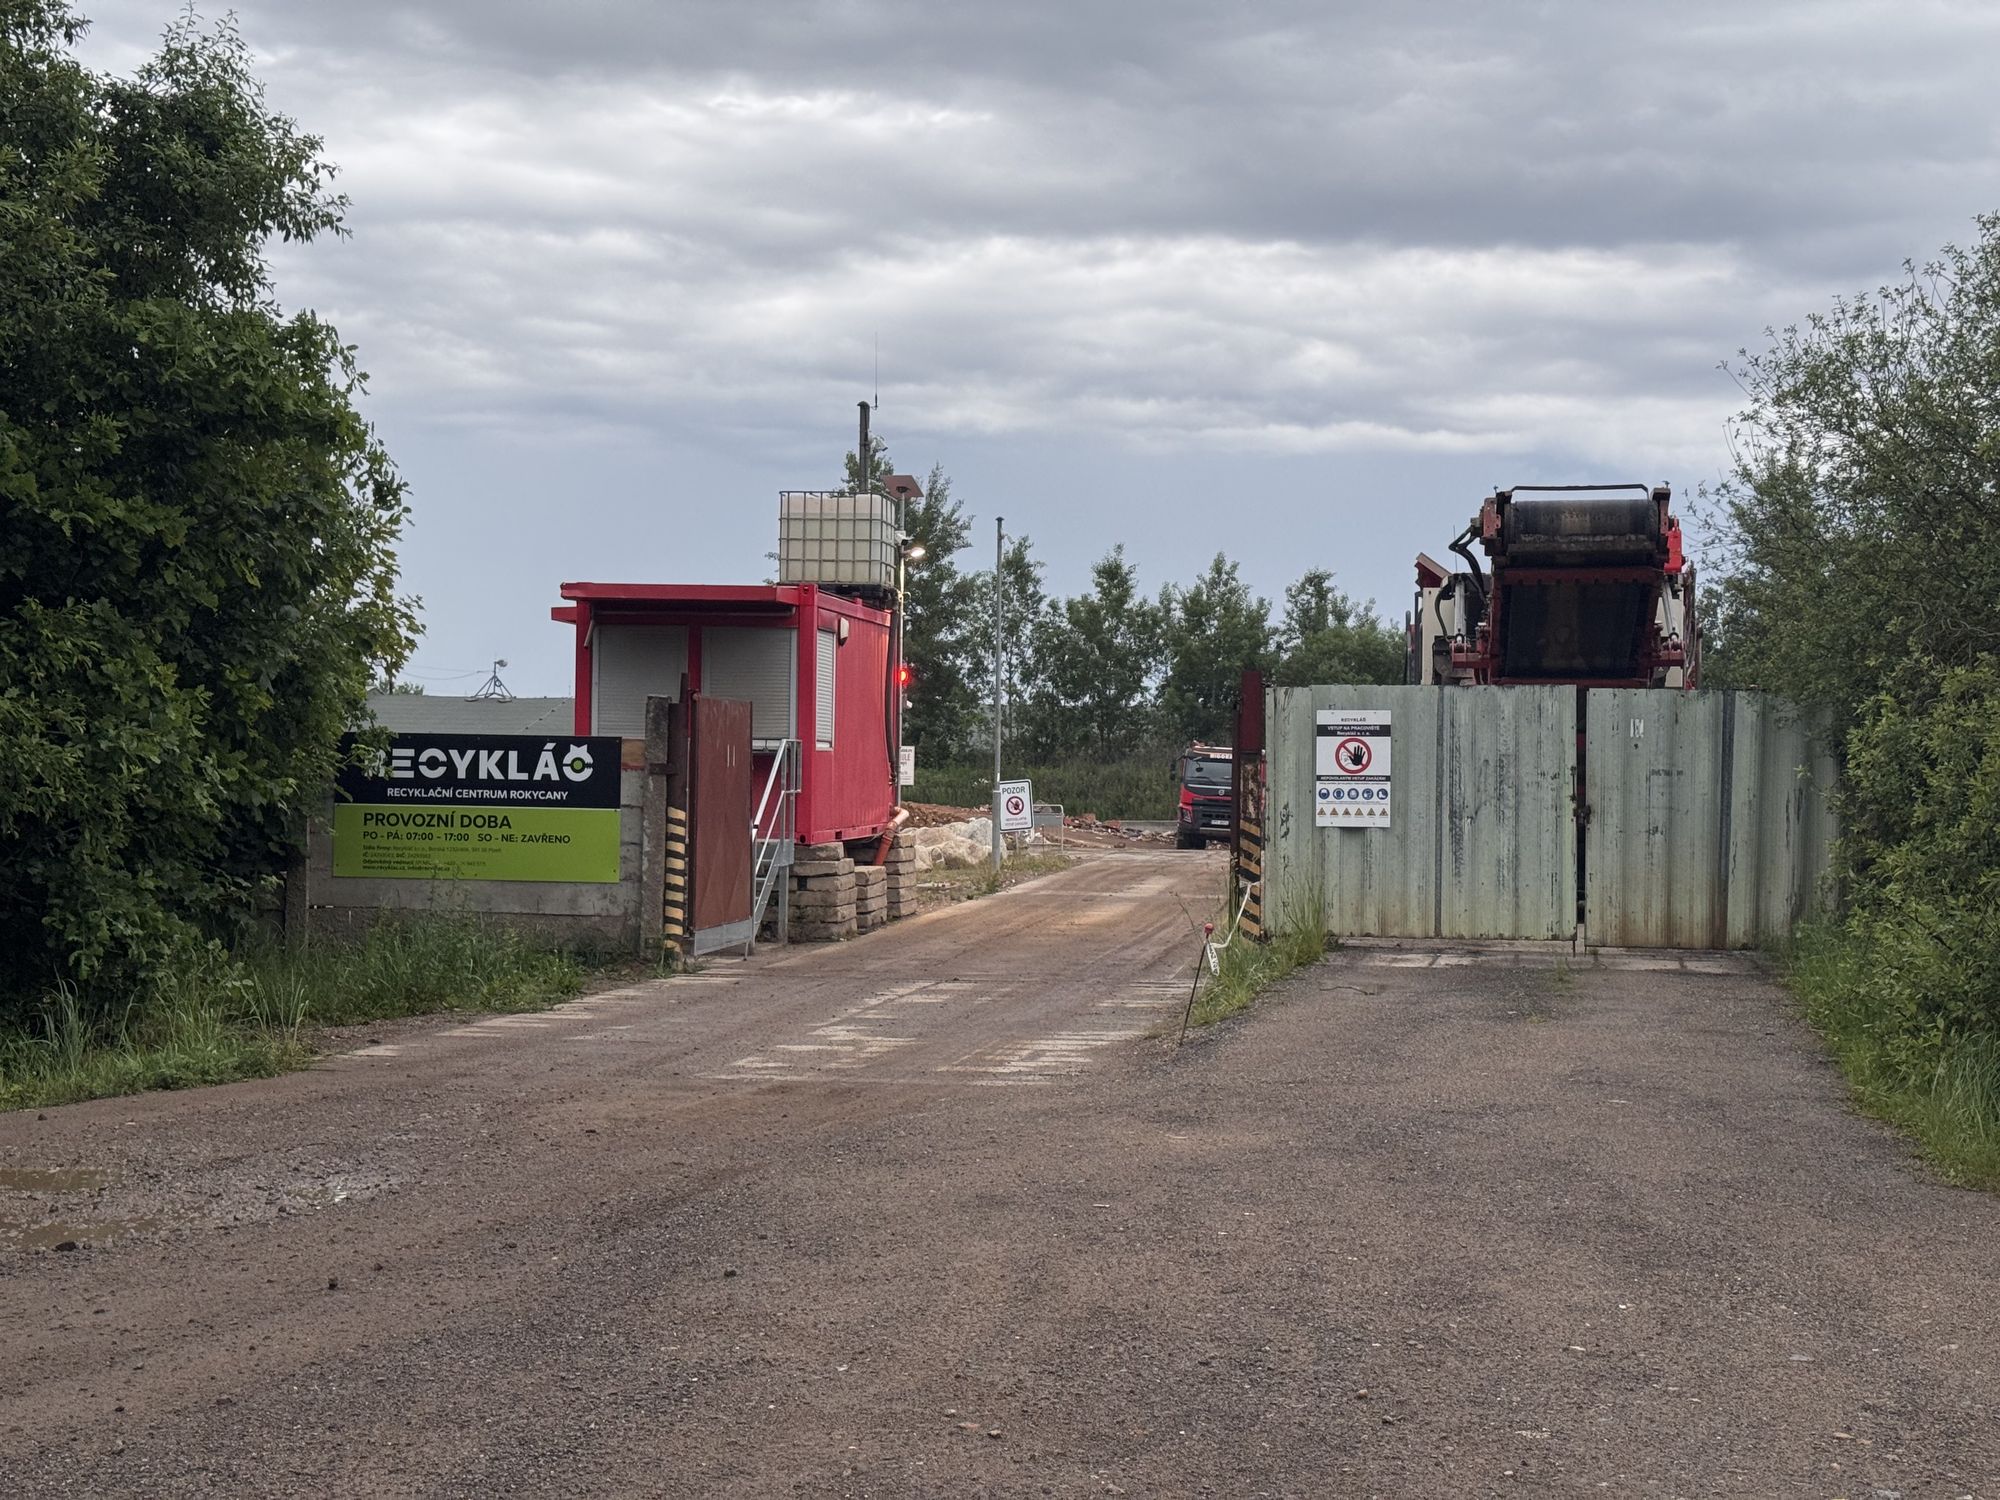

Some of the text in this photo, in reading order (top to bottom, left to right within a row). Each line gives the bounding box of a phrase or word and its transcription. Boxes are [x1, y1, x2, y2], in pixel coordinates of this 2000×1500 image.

[387, 787, 569, 800] RECYKLAČNÍ CENTRUM ROKYCANY
[1002, 786, 1026, 794] POZOR
[363, 811, 512, 829] PROVOZNÍ DOBA
[363, 831, 378, 840] PO
[386, 830, 403, 840] PÁ:
[406, 832, 434, 841] 07:00
[444, 833, 470, 842] 17:00
[477, 833, 493, 842] SO
[501, 834, 519, 843] NE:
[521, 833, 571, 844] ZAVŘENO
